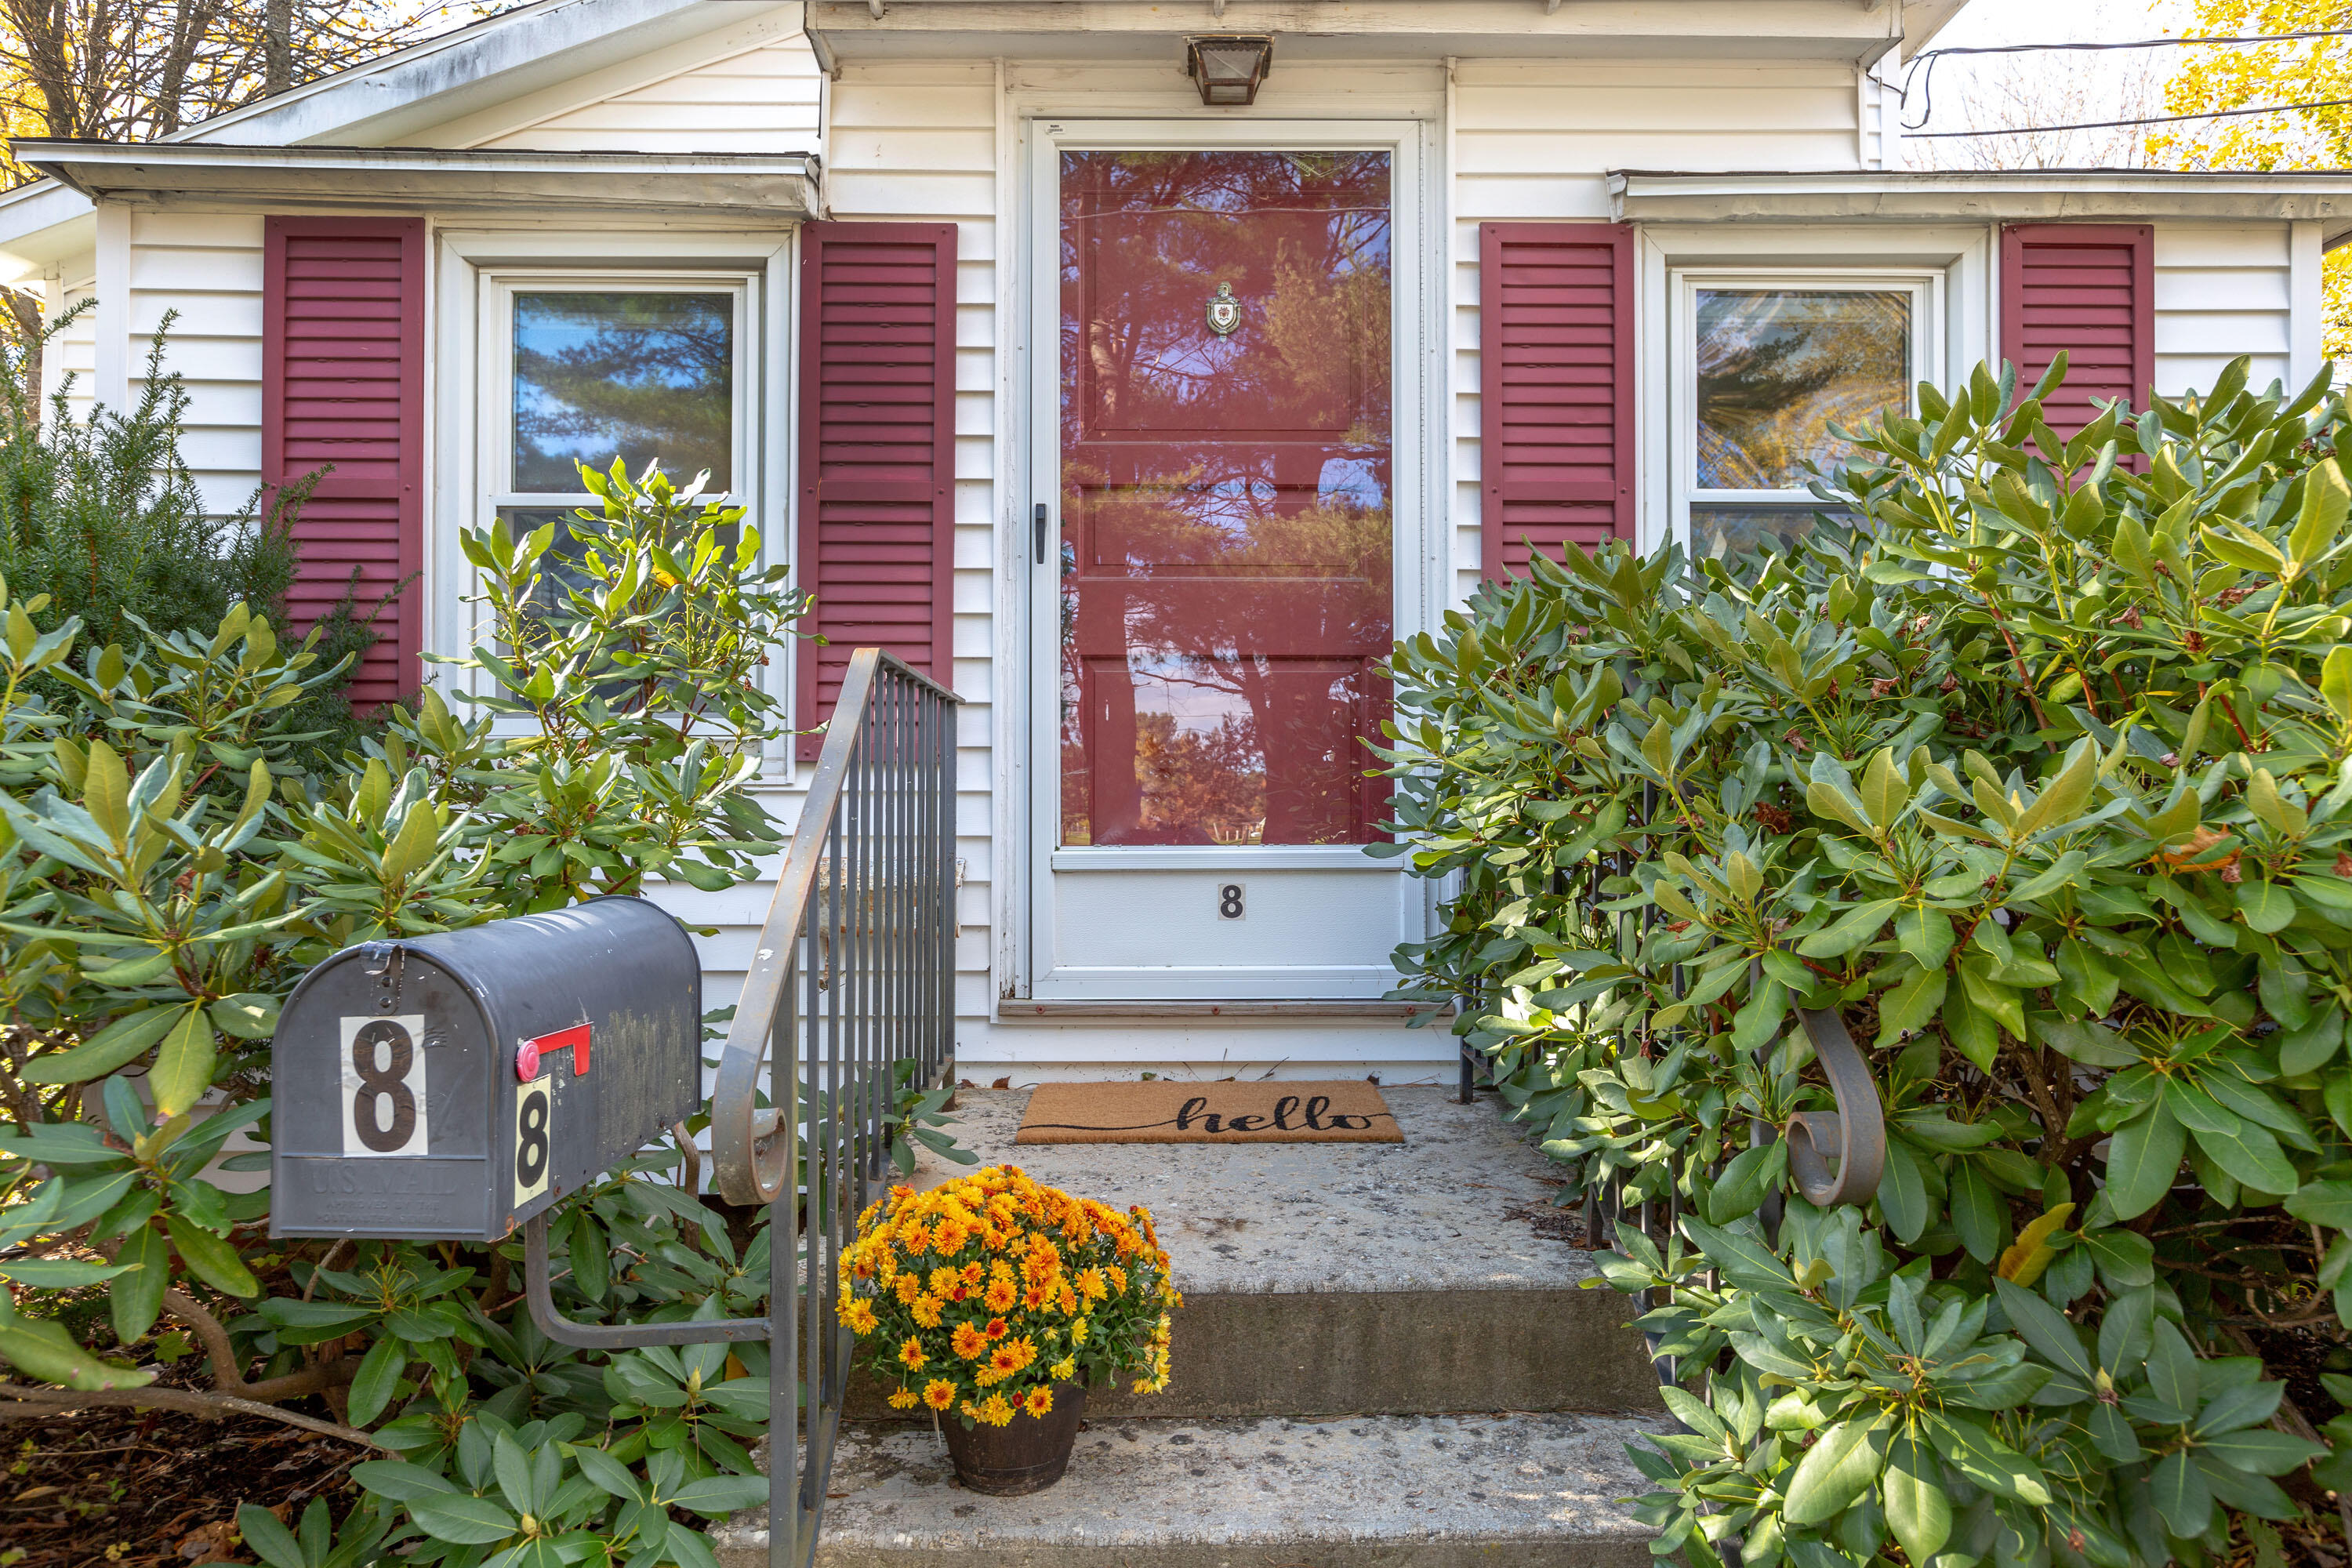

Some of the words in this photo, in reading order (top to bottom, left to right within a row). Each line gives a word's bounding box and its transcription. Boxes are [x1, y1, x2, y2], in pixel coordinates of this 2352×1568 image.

[1220, 884, 1243, 919] 8
[352, 1019, 416, 1153] 8
[1176, 1095, 1392, 1134] hello
[517, 1090, 549, 1189] 8
[370, 1163, 459, 1196] MAIL
